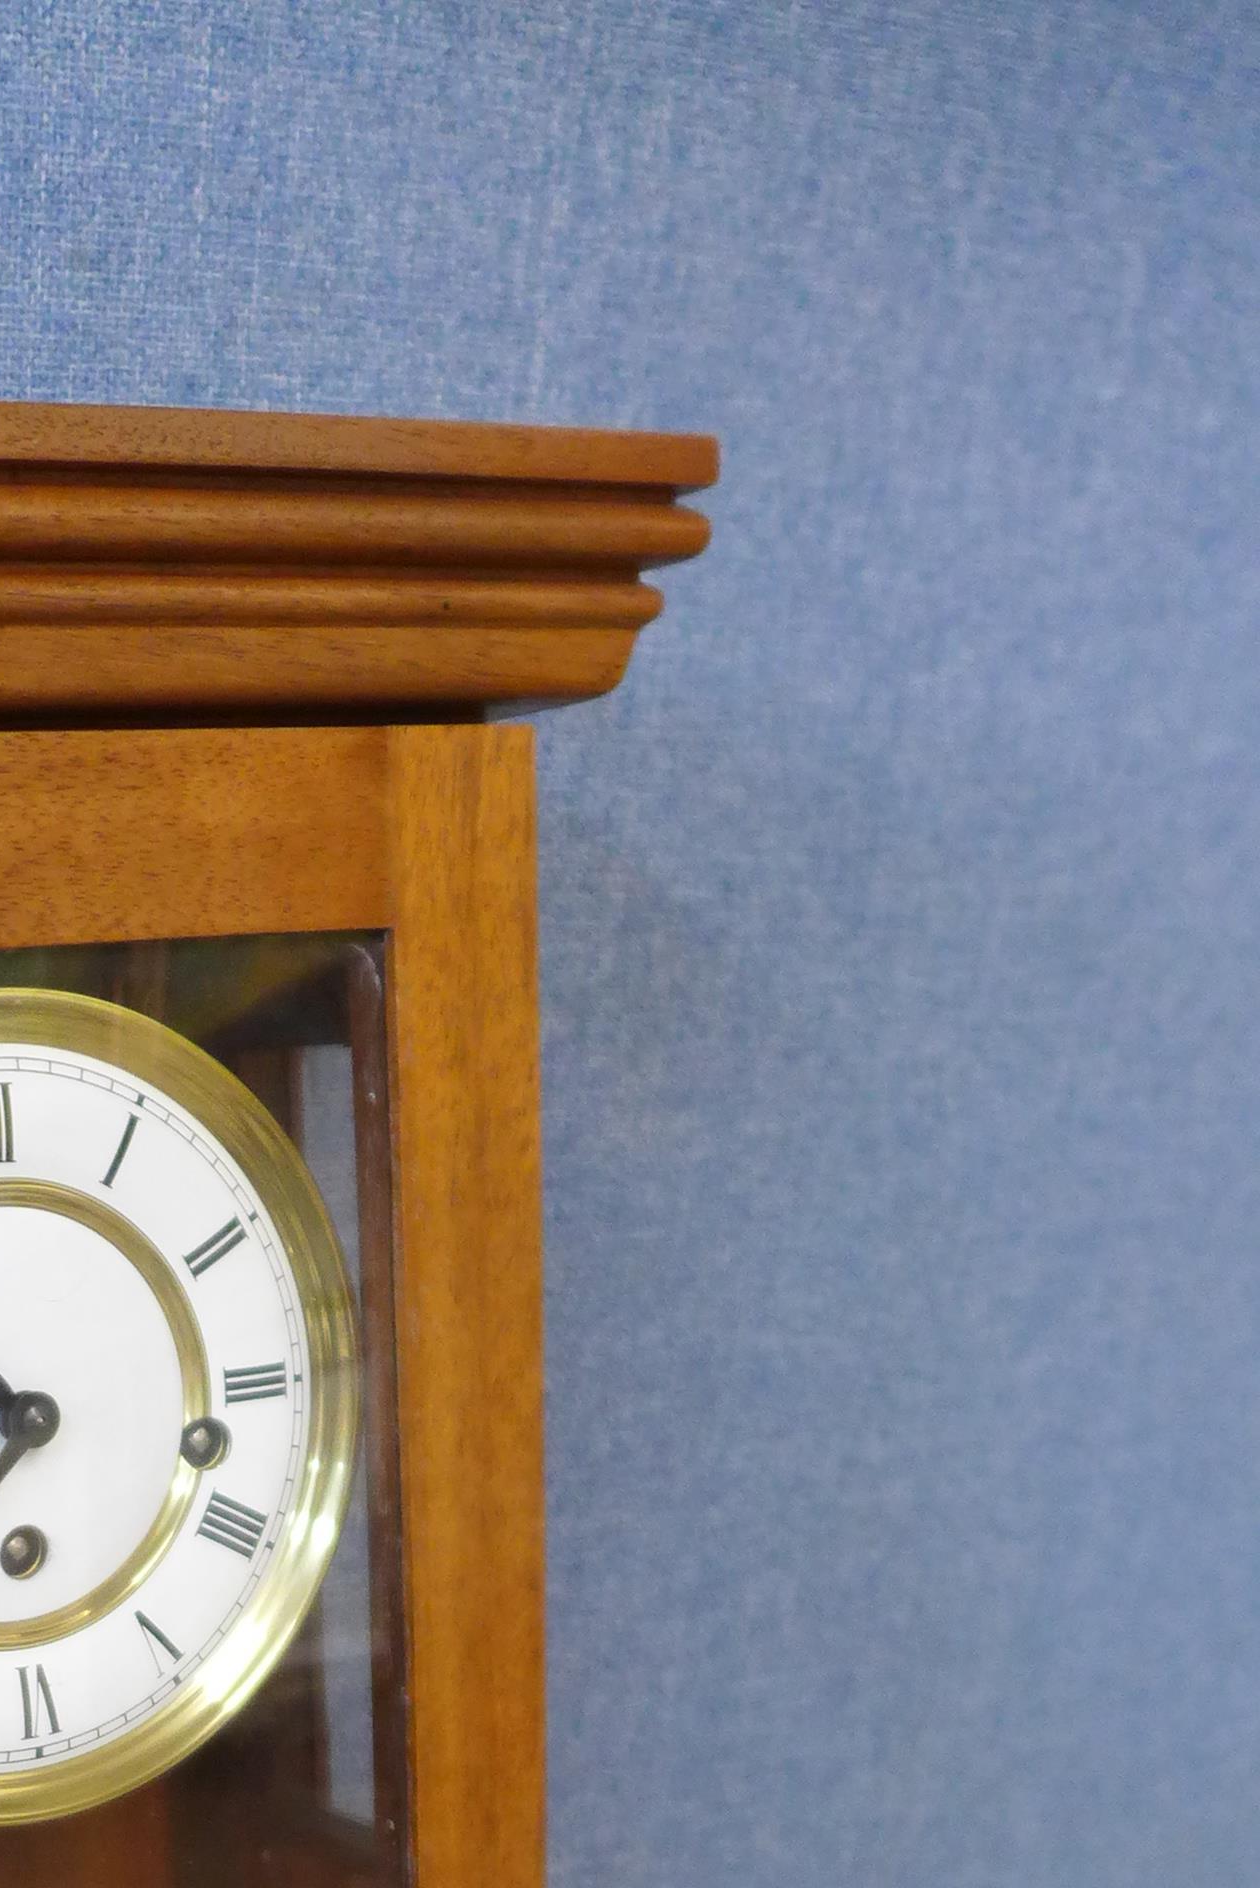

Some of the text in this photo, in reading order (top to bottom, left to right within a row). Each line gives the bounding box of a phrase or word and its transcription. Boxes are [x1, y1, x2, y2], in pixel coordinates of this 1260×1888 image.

[100, 1113, 141, 1187] I
[182, 1214, 250, 1279] II
[223, 1359, 288, 1408] III
[197, 1489, 269, 1562] IIII
[133, 1609, 185, 1679] V
[14, 1663, 61, 1741] VI
